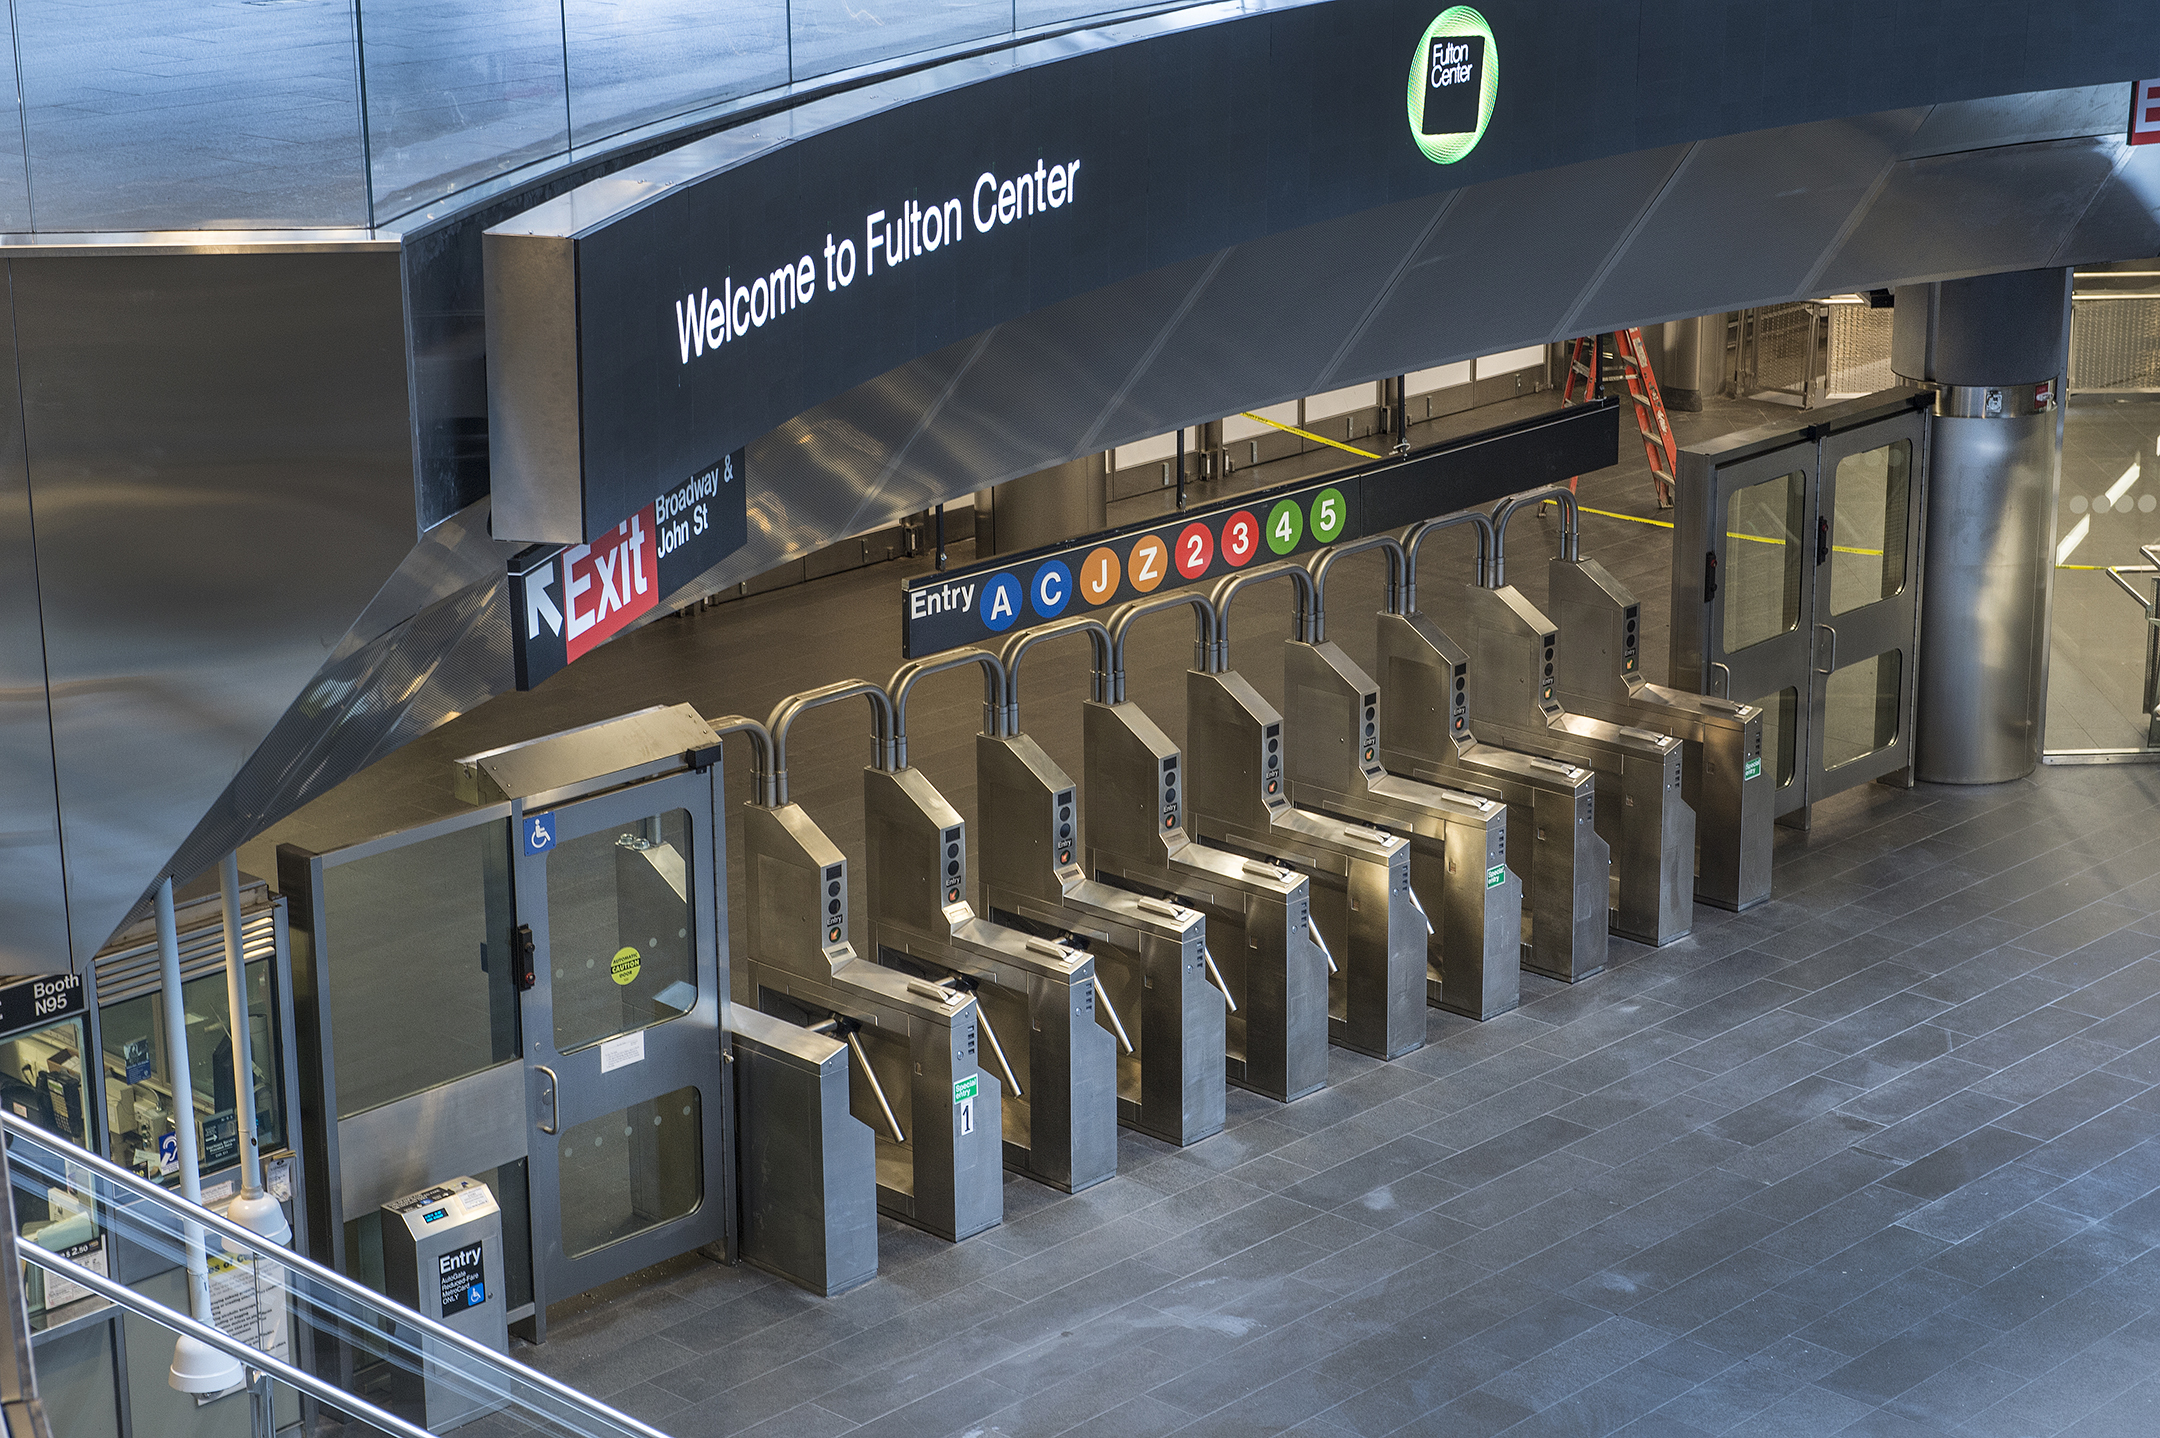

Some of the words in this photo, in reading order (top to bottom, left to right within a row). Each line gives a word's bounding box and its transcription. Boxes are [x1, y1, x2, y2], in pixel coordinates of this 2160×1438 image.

[1432, 42, 1468, 67] Fulton
[1431, 63, 1473, 88] Center
[675, 253, 816, 365] Welcome
[824, 233, 856, 291] to
[866, 197, 962, 276] Fulton
[972, 158, 1081, 234] Center
[655, 468, 719, 526] Broadway
[724, 454, 734, 483] &
[657, 520, 689, 559] John
[693, 503, 709, 535] St
[910, 582, 975, 620] Entry
[991, 585, 1013, 621] A
[1040, 571, 1062, 606] C
[1092, 559, 1108, 594] J
[1139, 546, 1158, 582] Z
[1187, 534, 1204, 568] 2
[1232, 522, 1250, 555] 3
[1275, 511, 1293, 542] 4
[1319, 499, 1336, 531] 5
[562, 514, 648, 642] Exit
[946, 877, 960, 887] Entry
[827, 915, 842, 925] Entry
[611, 958, 640, 973] CAUTION
[33, 974, 80, 999] Booth
[35, 993, 68, 1016] N95
[955, 1078, 977, 1093] Special
[955, 1089, 971, 1100] entry
[962, 1105, 970, 1132] 1
[440, 1247, 482, 1274] Entry
[442, 1293, 459, 1305] ONLY
